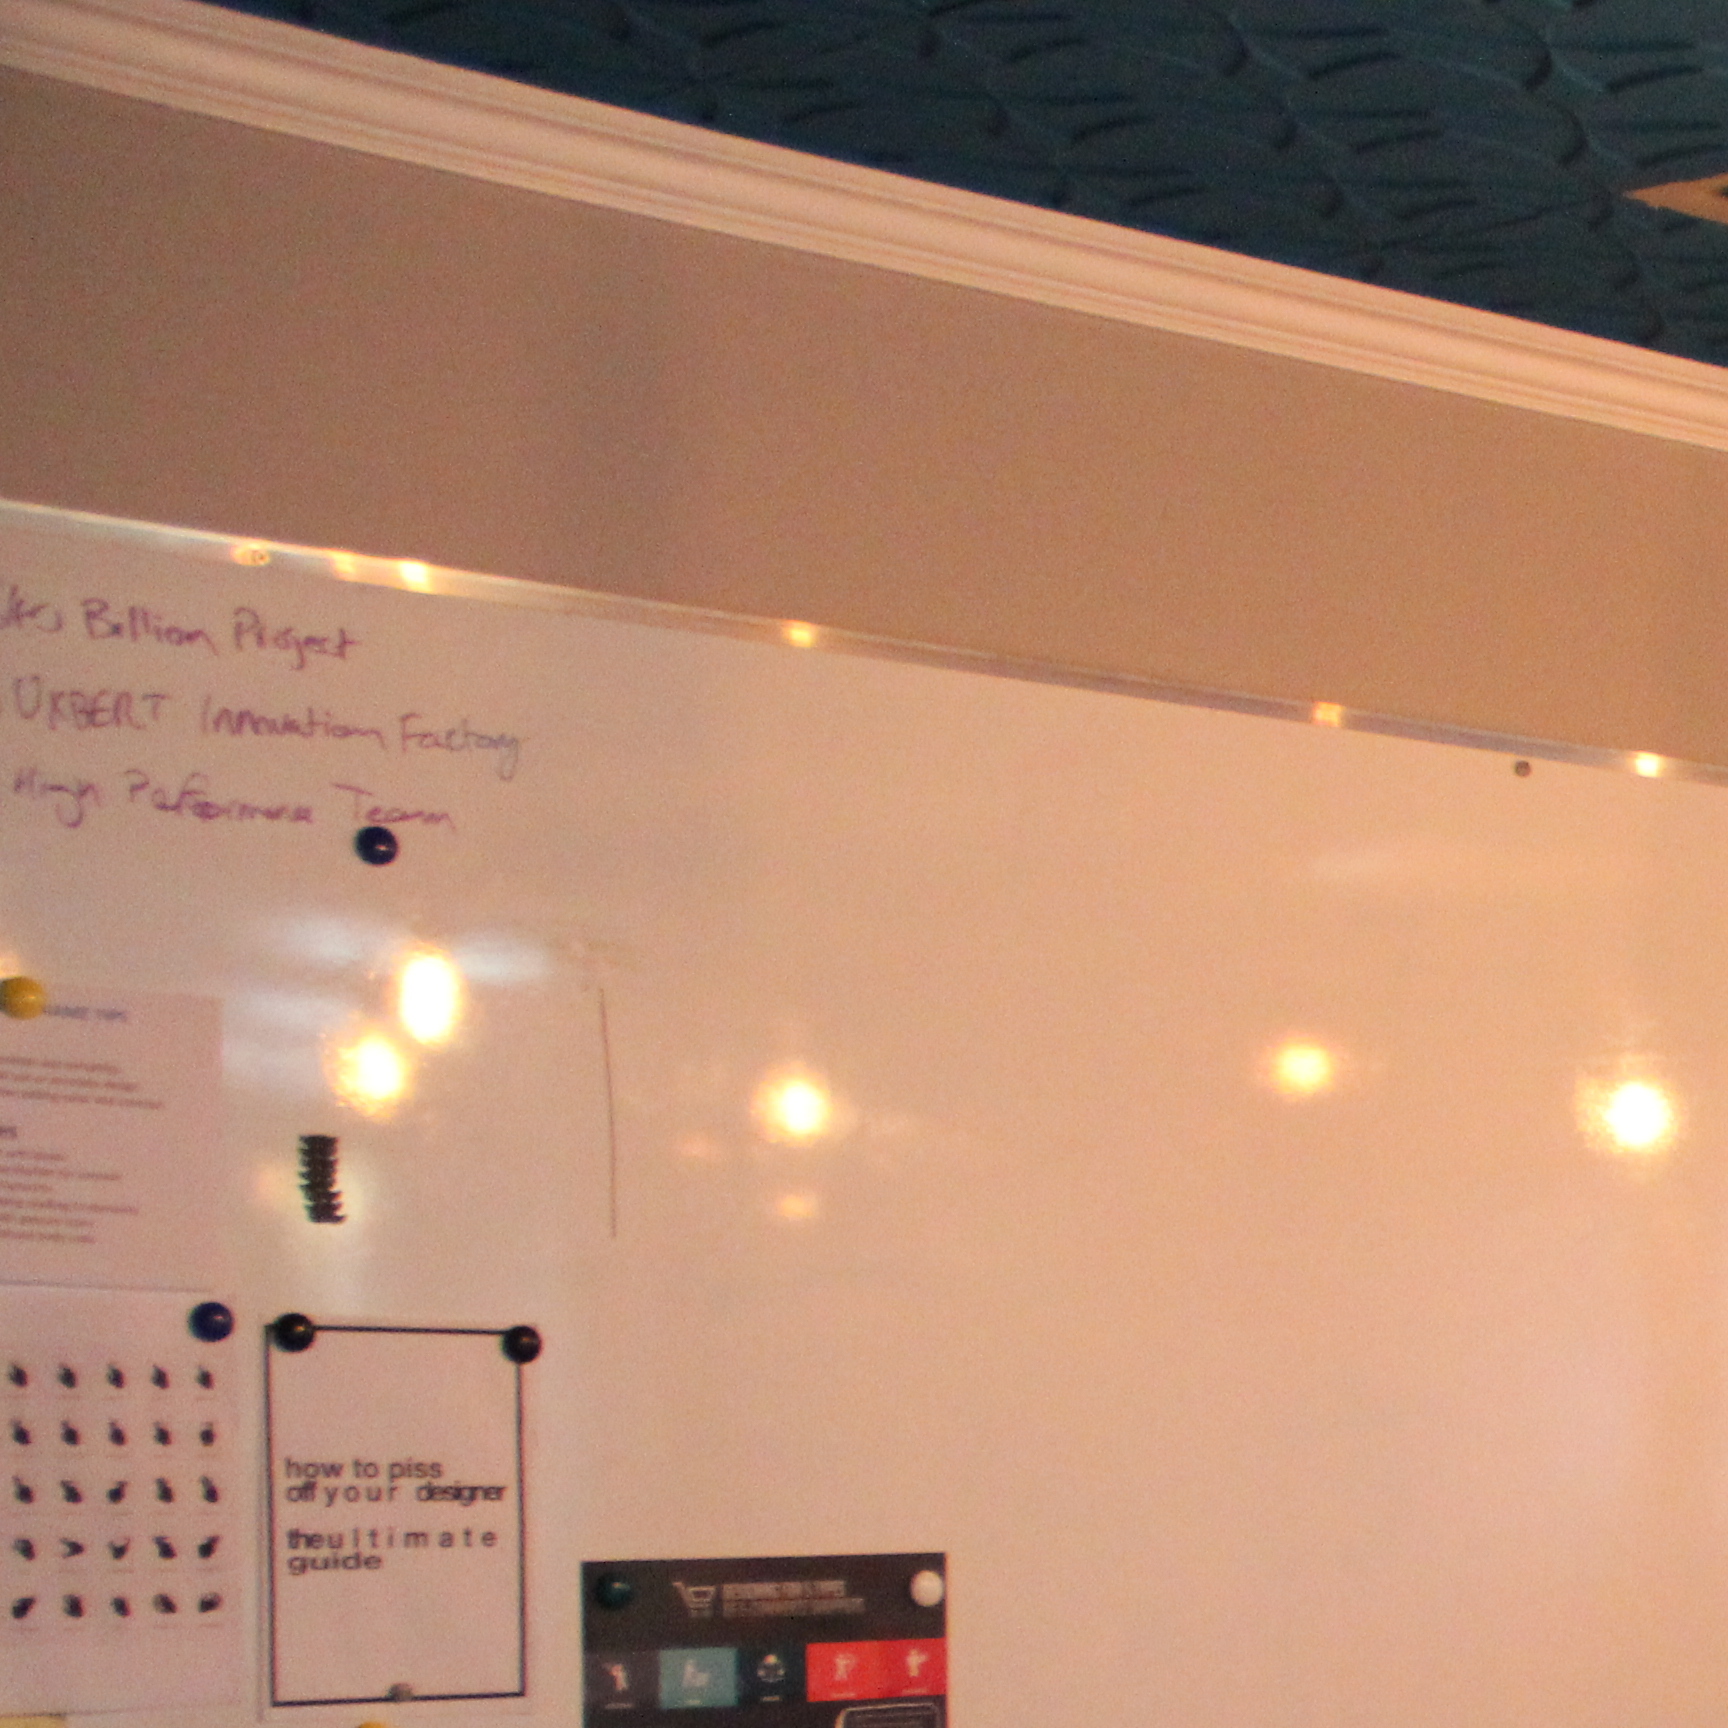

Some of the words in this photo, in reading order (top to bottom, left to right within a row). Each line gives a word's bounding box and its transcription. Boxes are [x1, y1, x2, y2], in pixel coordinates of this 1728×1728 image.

[284, 1457, 344, 1479] how
[352, 1458, 380, 1479] to
[387, 1458, 444, 1483] piss
[324, 1484, 399, 1507] your
[286, 1552, 384, 1576] guide
